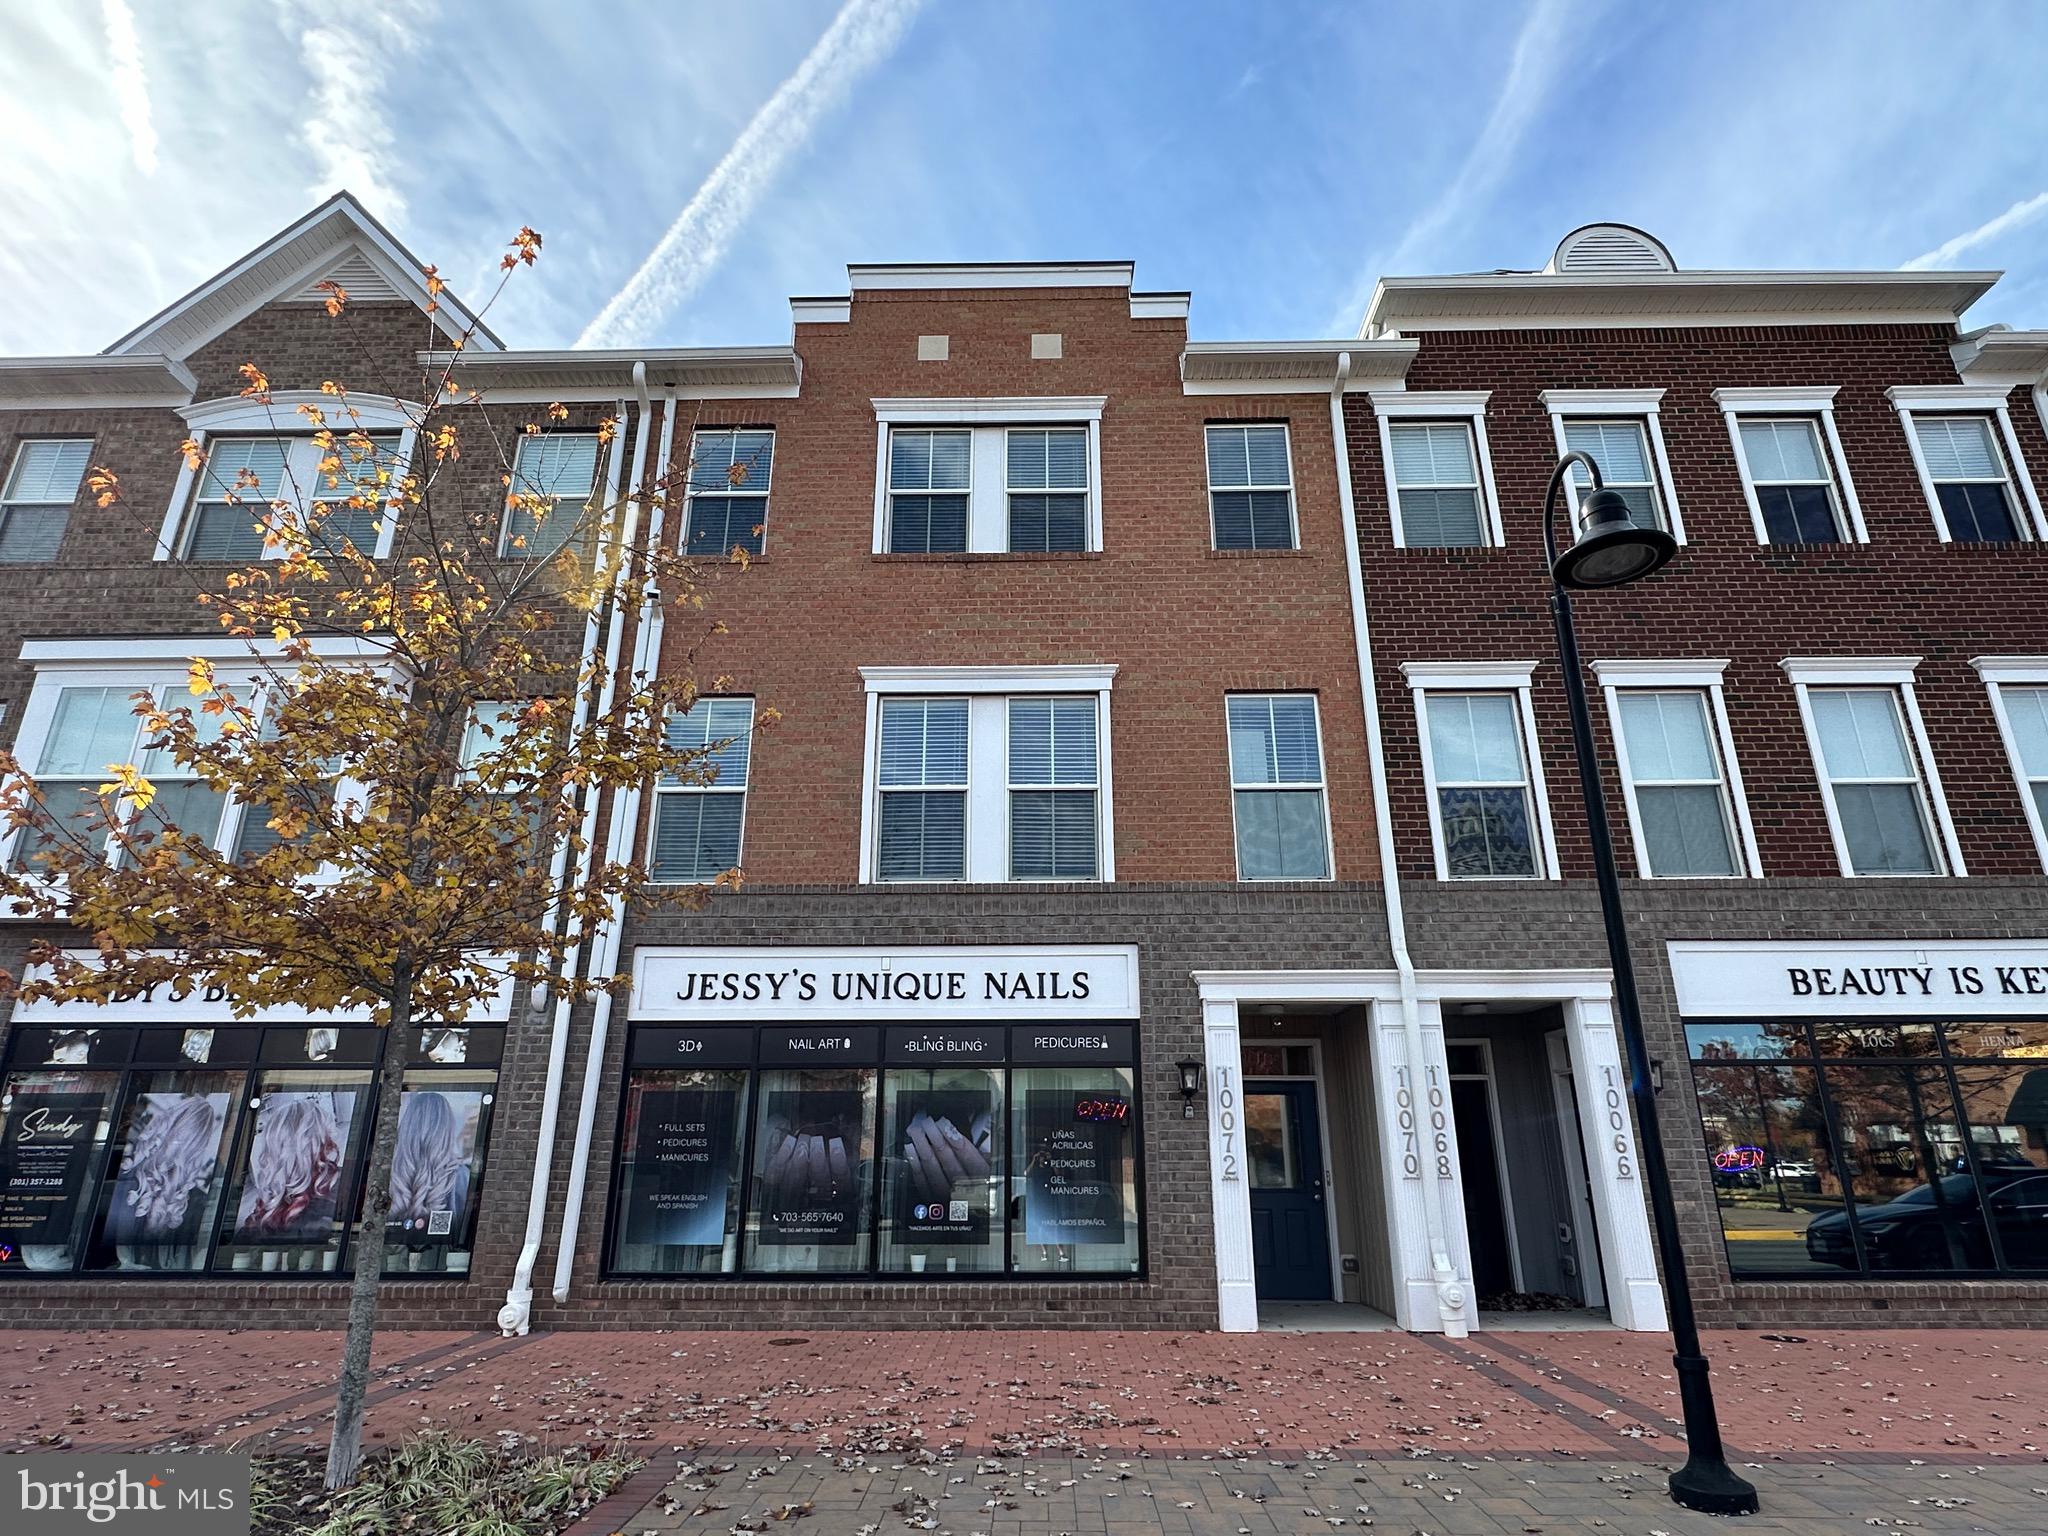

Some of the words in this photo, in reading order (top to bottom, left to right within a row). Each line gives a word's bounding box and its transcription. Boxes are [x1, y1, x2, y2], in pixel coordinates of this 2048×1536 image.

[677, 968, 817, 1001] JESSY'S
[832, 971, 966, 1001] UNIQUE
[983, 971, 1091, 1000] NAILS
[1787, 967, 1934, 996] BEAUTY
[1947, 966, 1984, 995] IS
[677, 1040, 696, 1052] 3D
[788, 1038, 816, 1050] NAIL
[817, 1038, 841, 1050] ART
[908, 1040, 944, 1052] BLING
[946, 1040, 983, 1052] BLING
[1034, 1037, 1101, 1049] PEDICURES
[1859, 1034, 1895, 1048] LOCS
[1979, 1035, 2026, 1047] HENNA
[1076, 1100, 1128, 1118] OPEN
[17, 1107, 84, 1142] Sindy
[1220, 1067, 1237, 1176] 10072
[1396, 1067, 1419, 1175] 10070
[1427, 1066, 1451, 1176] 10068
[1604, 1066, 1631, 1176] 10066
[663, 1123, 683, 1132] FULL
[685, 1123, 706, 1132] SETS
[1051, 1129, 1075, 1139] UÑAS
[662, 1138, 708, 1147] PEDICURES
[1051, 1141, 1094, 1150] ACRILICAS
[661, 1153, 709, 1162] MANICURES
[1050, 1159, 1096, 1168] PEDICURES
[1714, 1150, 1764, 1168] OPEN
[1050, 1175, 1067, 1184] GEL
[1050, 1186, 1100, 1195] MANICURES
[681, 1193, 708, 1201] ENGLISH
[671, 1202, 699, 1210] SPANISH
[781, 1211, 844, 1222] 703-565-7640
[1077, 1217, 1107, 1226] ESPAÑOL
